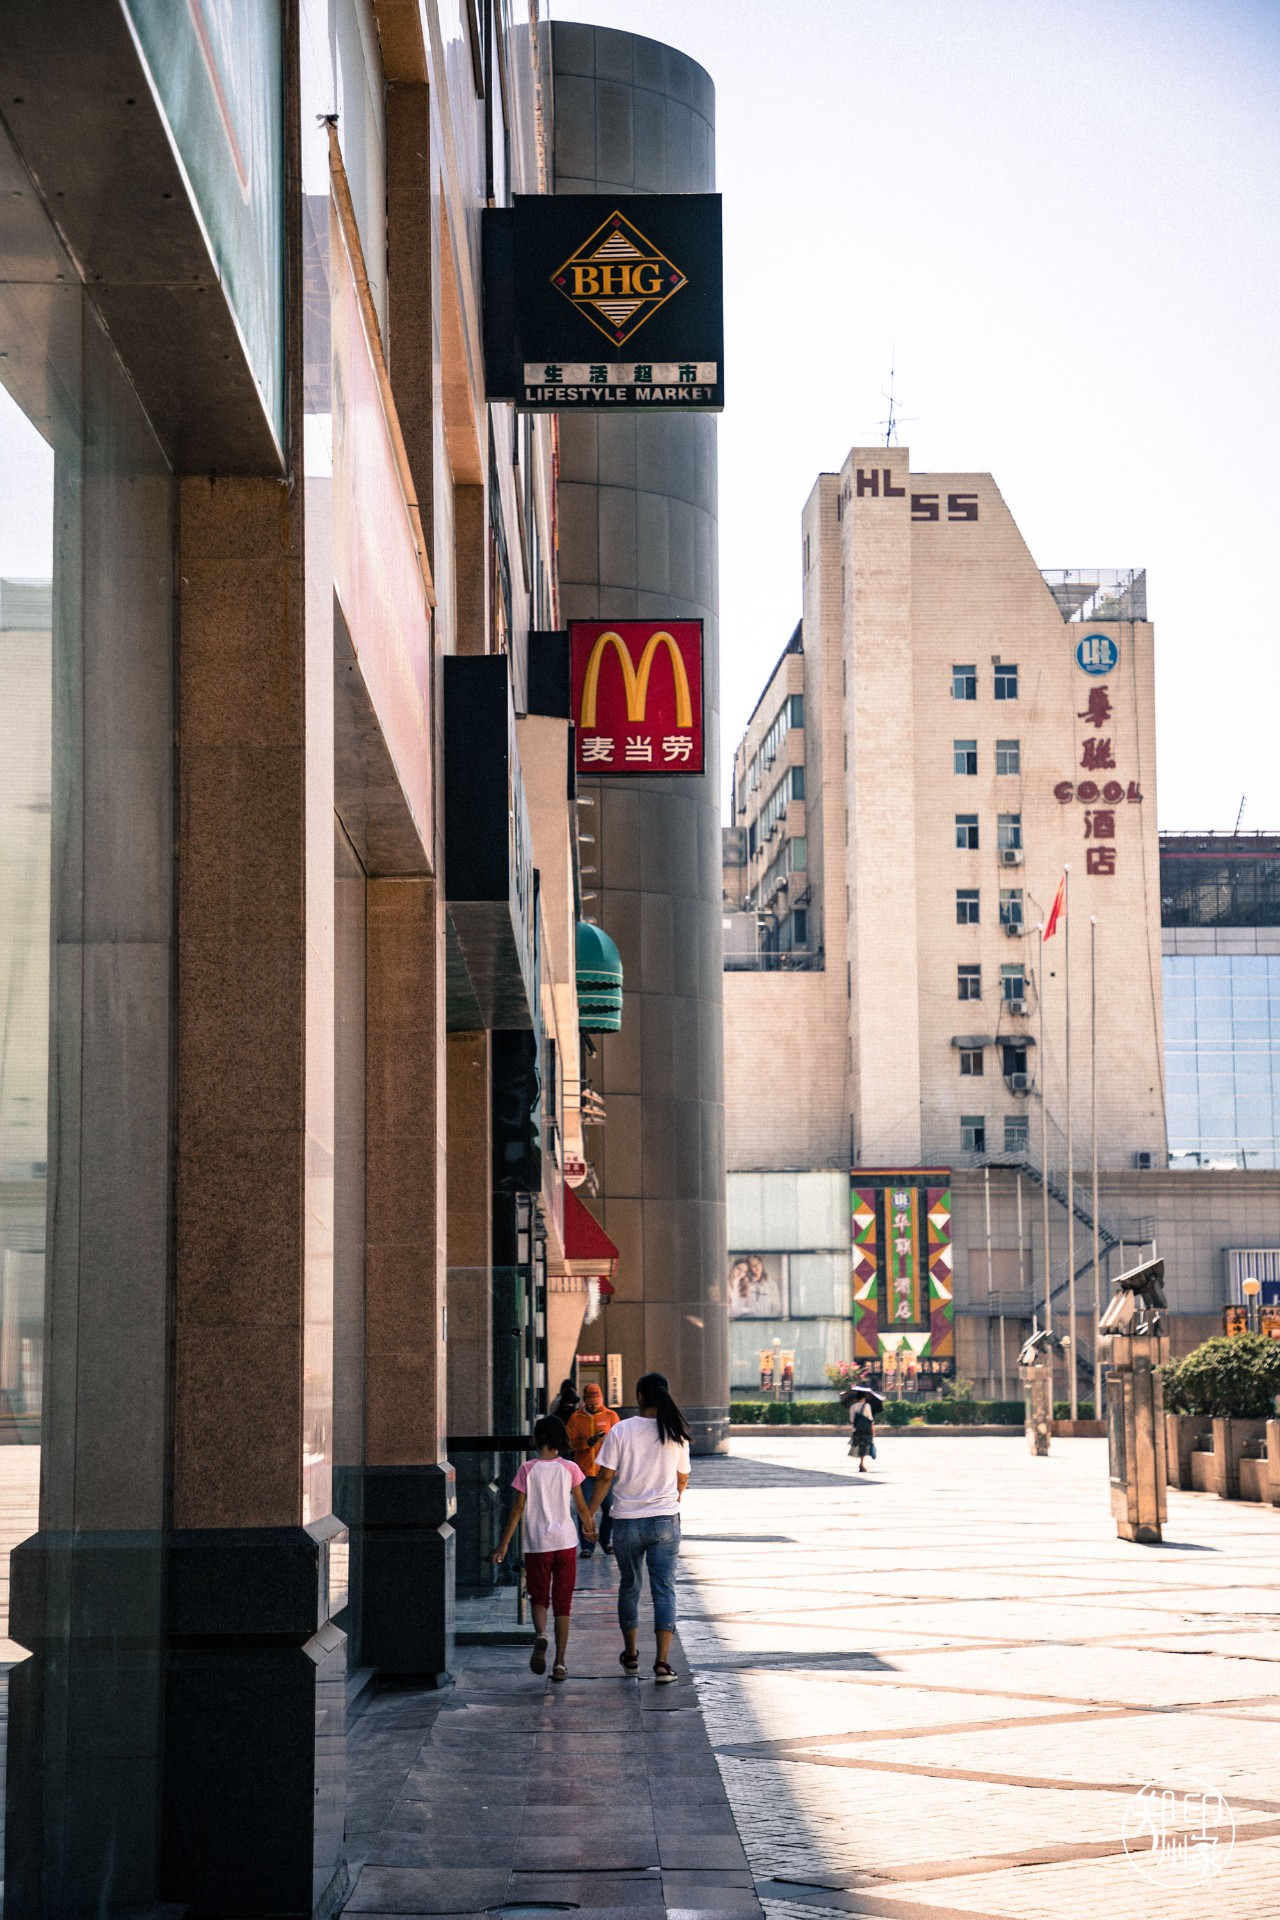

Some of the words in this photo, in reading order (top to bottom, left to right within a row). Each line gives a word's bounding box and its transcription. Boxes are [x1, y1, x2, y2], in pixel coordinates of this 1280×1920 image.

[571, 263, 664, 296] BHG
[544, 364, 699, 384] 生活超市
[525, 387, 628, 401] LIFESTYLE
[635, 386, 714, 401] MARKET
[856, 468, 906, 497] HL
[581, 735, 693, 762] 麦当劳
[1053, 780, 1144, 804] COOL
[1084, 809, 1117, 876] 酒店
